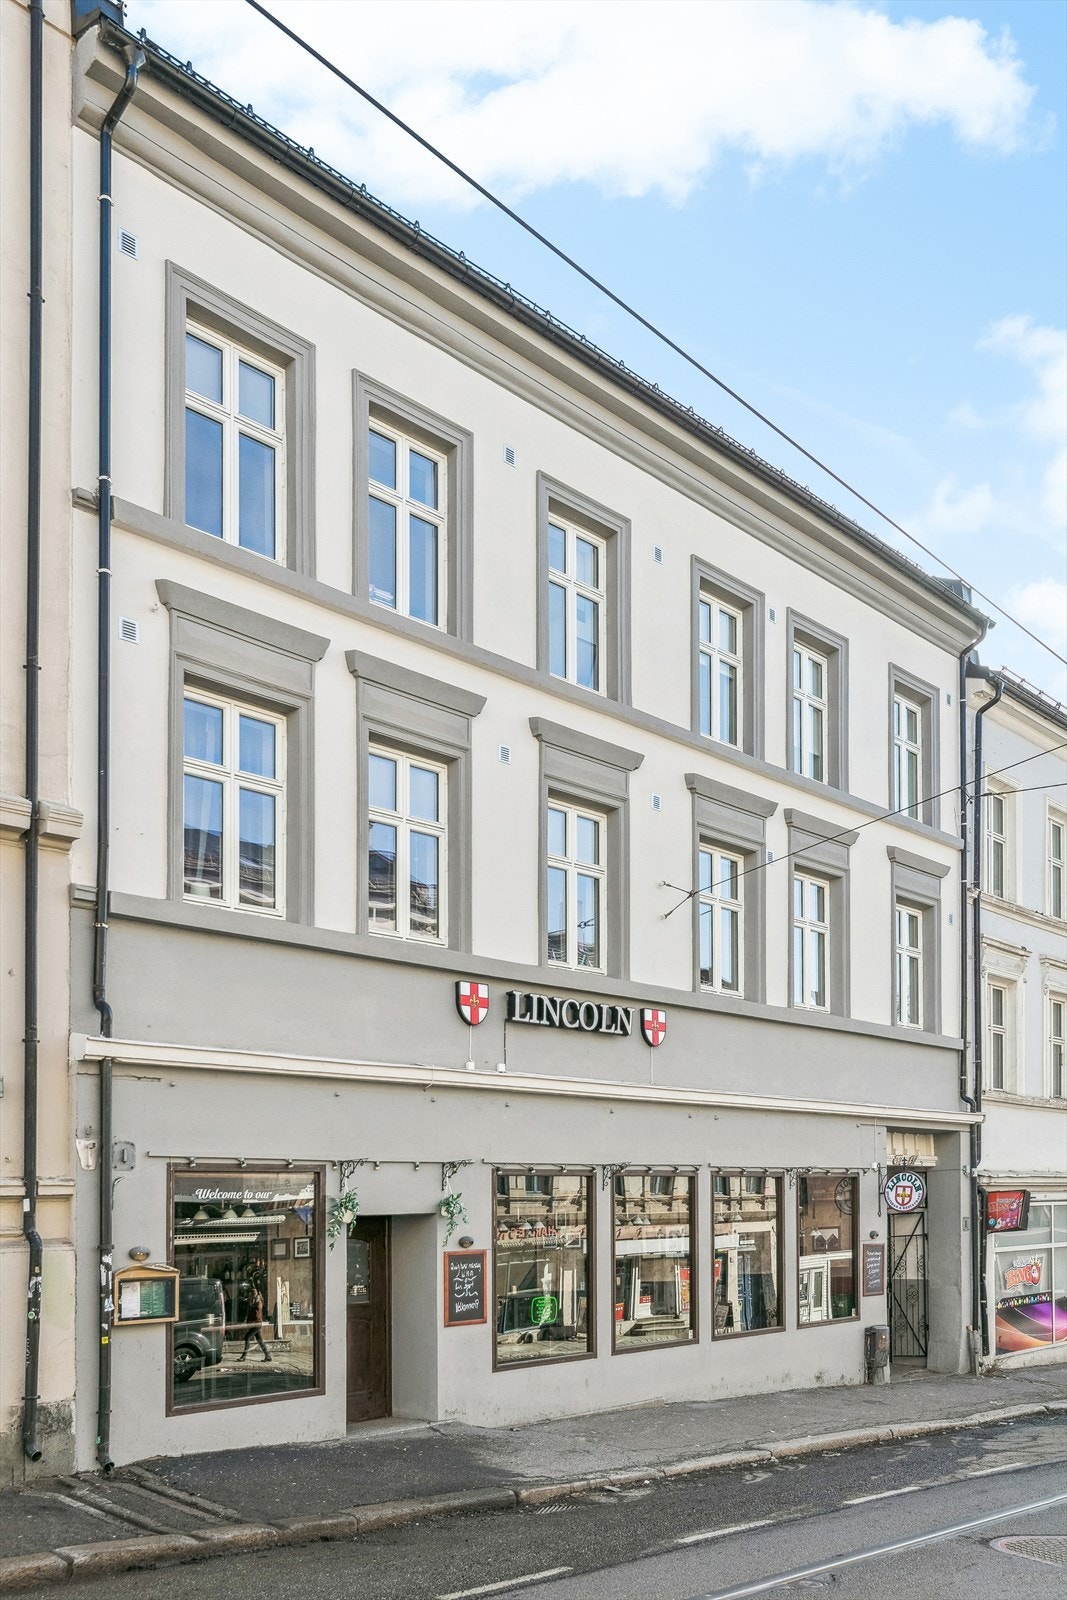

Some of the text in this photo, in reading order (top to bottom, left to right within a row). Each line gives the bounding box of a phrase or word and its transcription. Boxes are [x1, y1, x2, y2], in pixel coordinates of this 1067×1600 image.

[508, 990, 635, 1035] LINCOLN
[195, 1188, 272, 1199] Welcome to our
[886, 1173, 922, 1192] LINCOLN
[1006, 1264, 1040, 1290] BINGO
